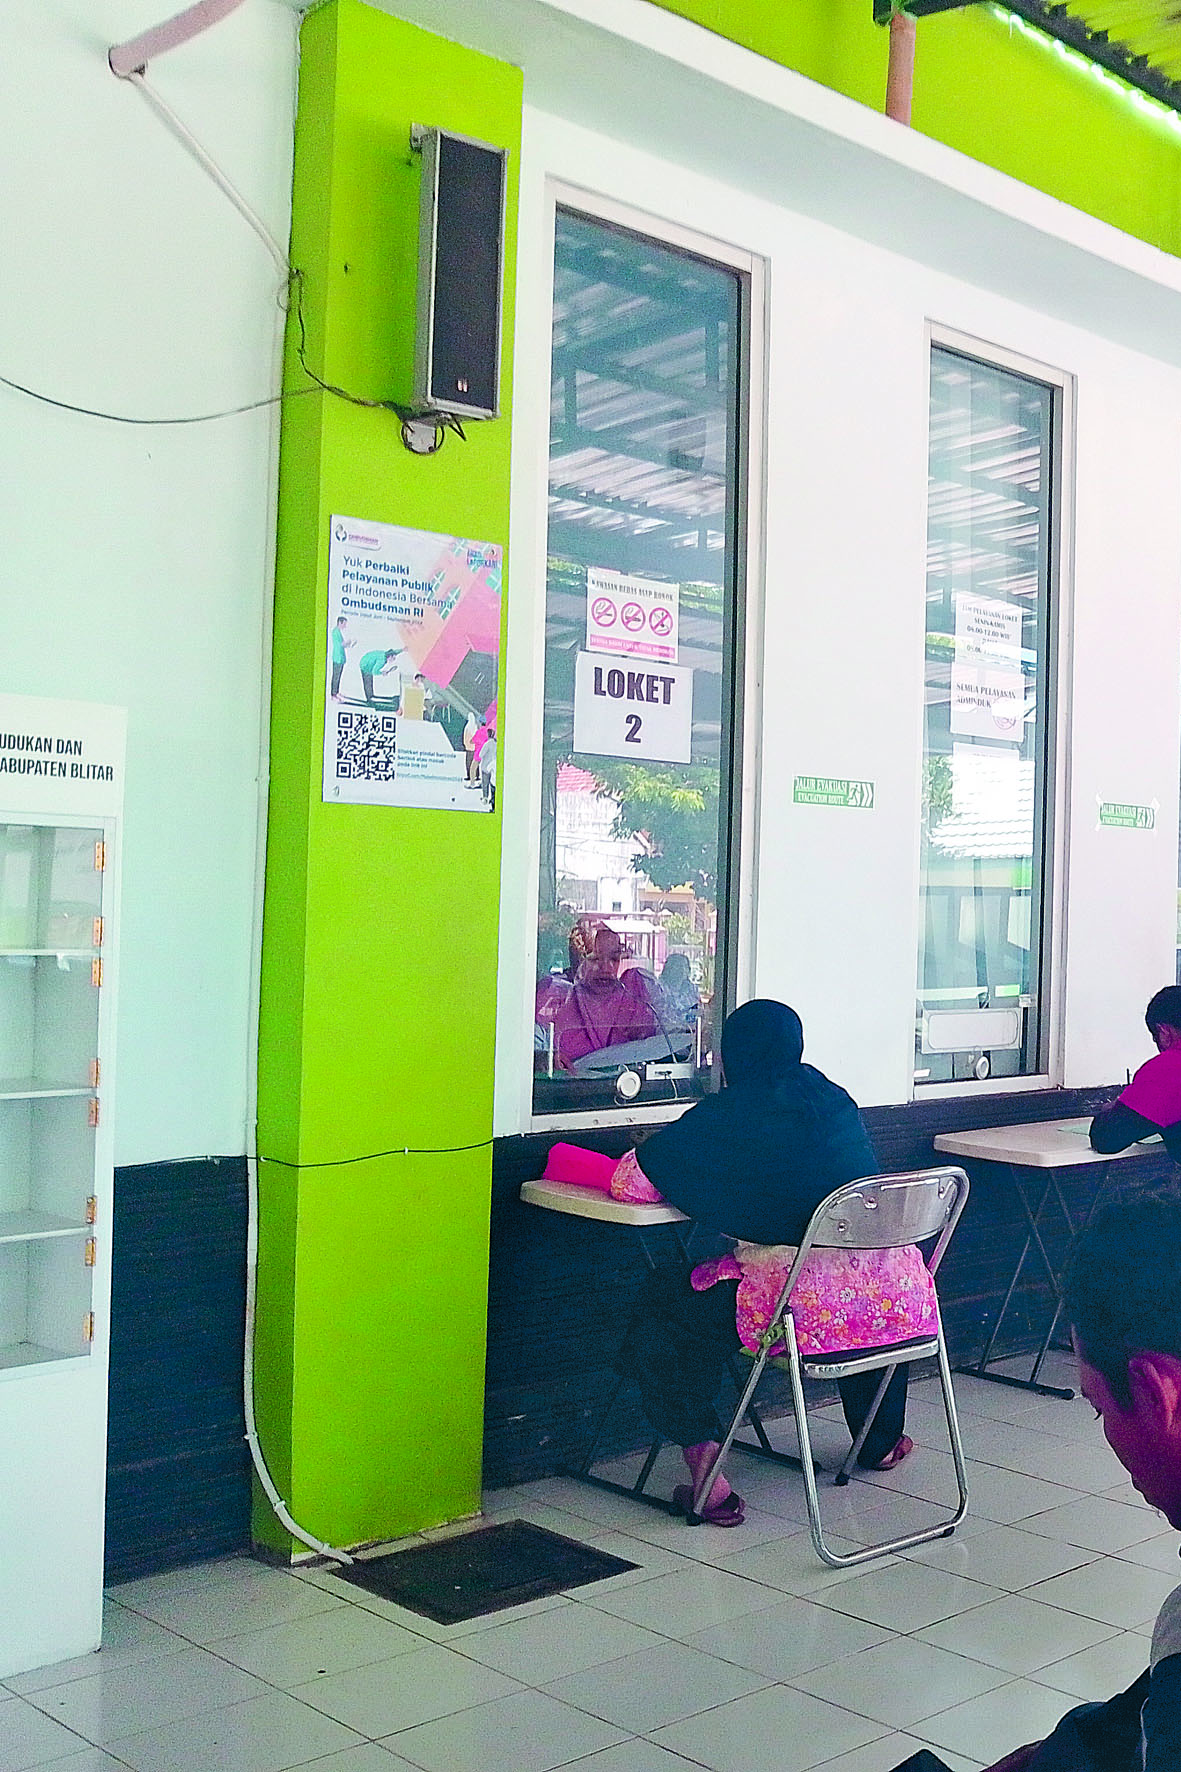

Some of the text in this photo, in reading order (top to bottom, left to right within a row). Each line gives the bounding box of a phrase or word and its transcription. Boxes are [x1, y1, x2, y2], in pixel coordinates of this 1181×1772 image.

[344, 556, 410, 576] Yuk Perbaiki
[342, 570, 434, 592] Pelayanan Publik
[342, 584, 454, 609] di Indonesia Bersama
[342, 597, 424, 618] Ombudsman RI
[594, 666, 676, 705] LOKET
[980, 686, 1016, 700] PELAYANAN
[624, 714, 642, 744] 2
[0, 733, 82, 756] UDUKAN DAN
[0, 757, 114, 782] ABUPATEN BLITAR
